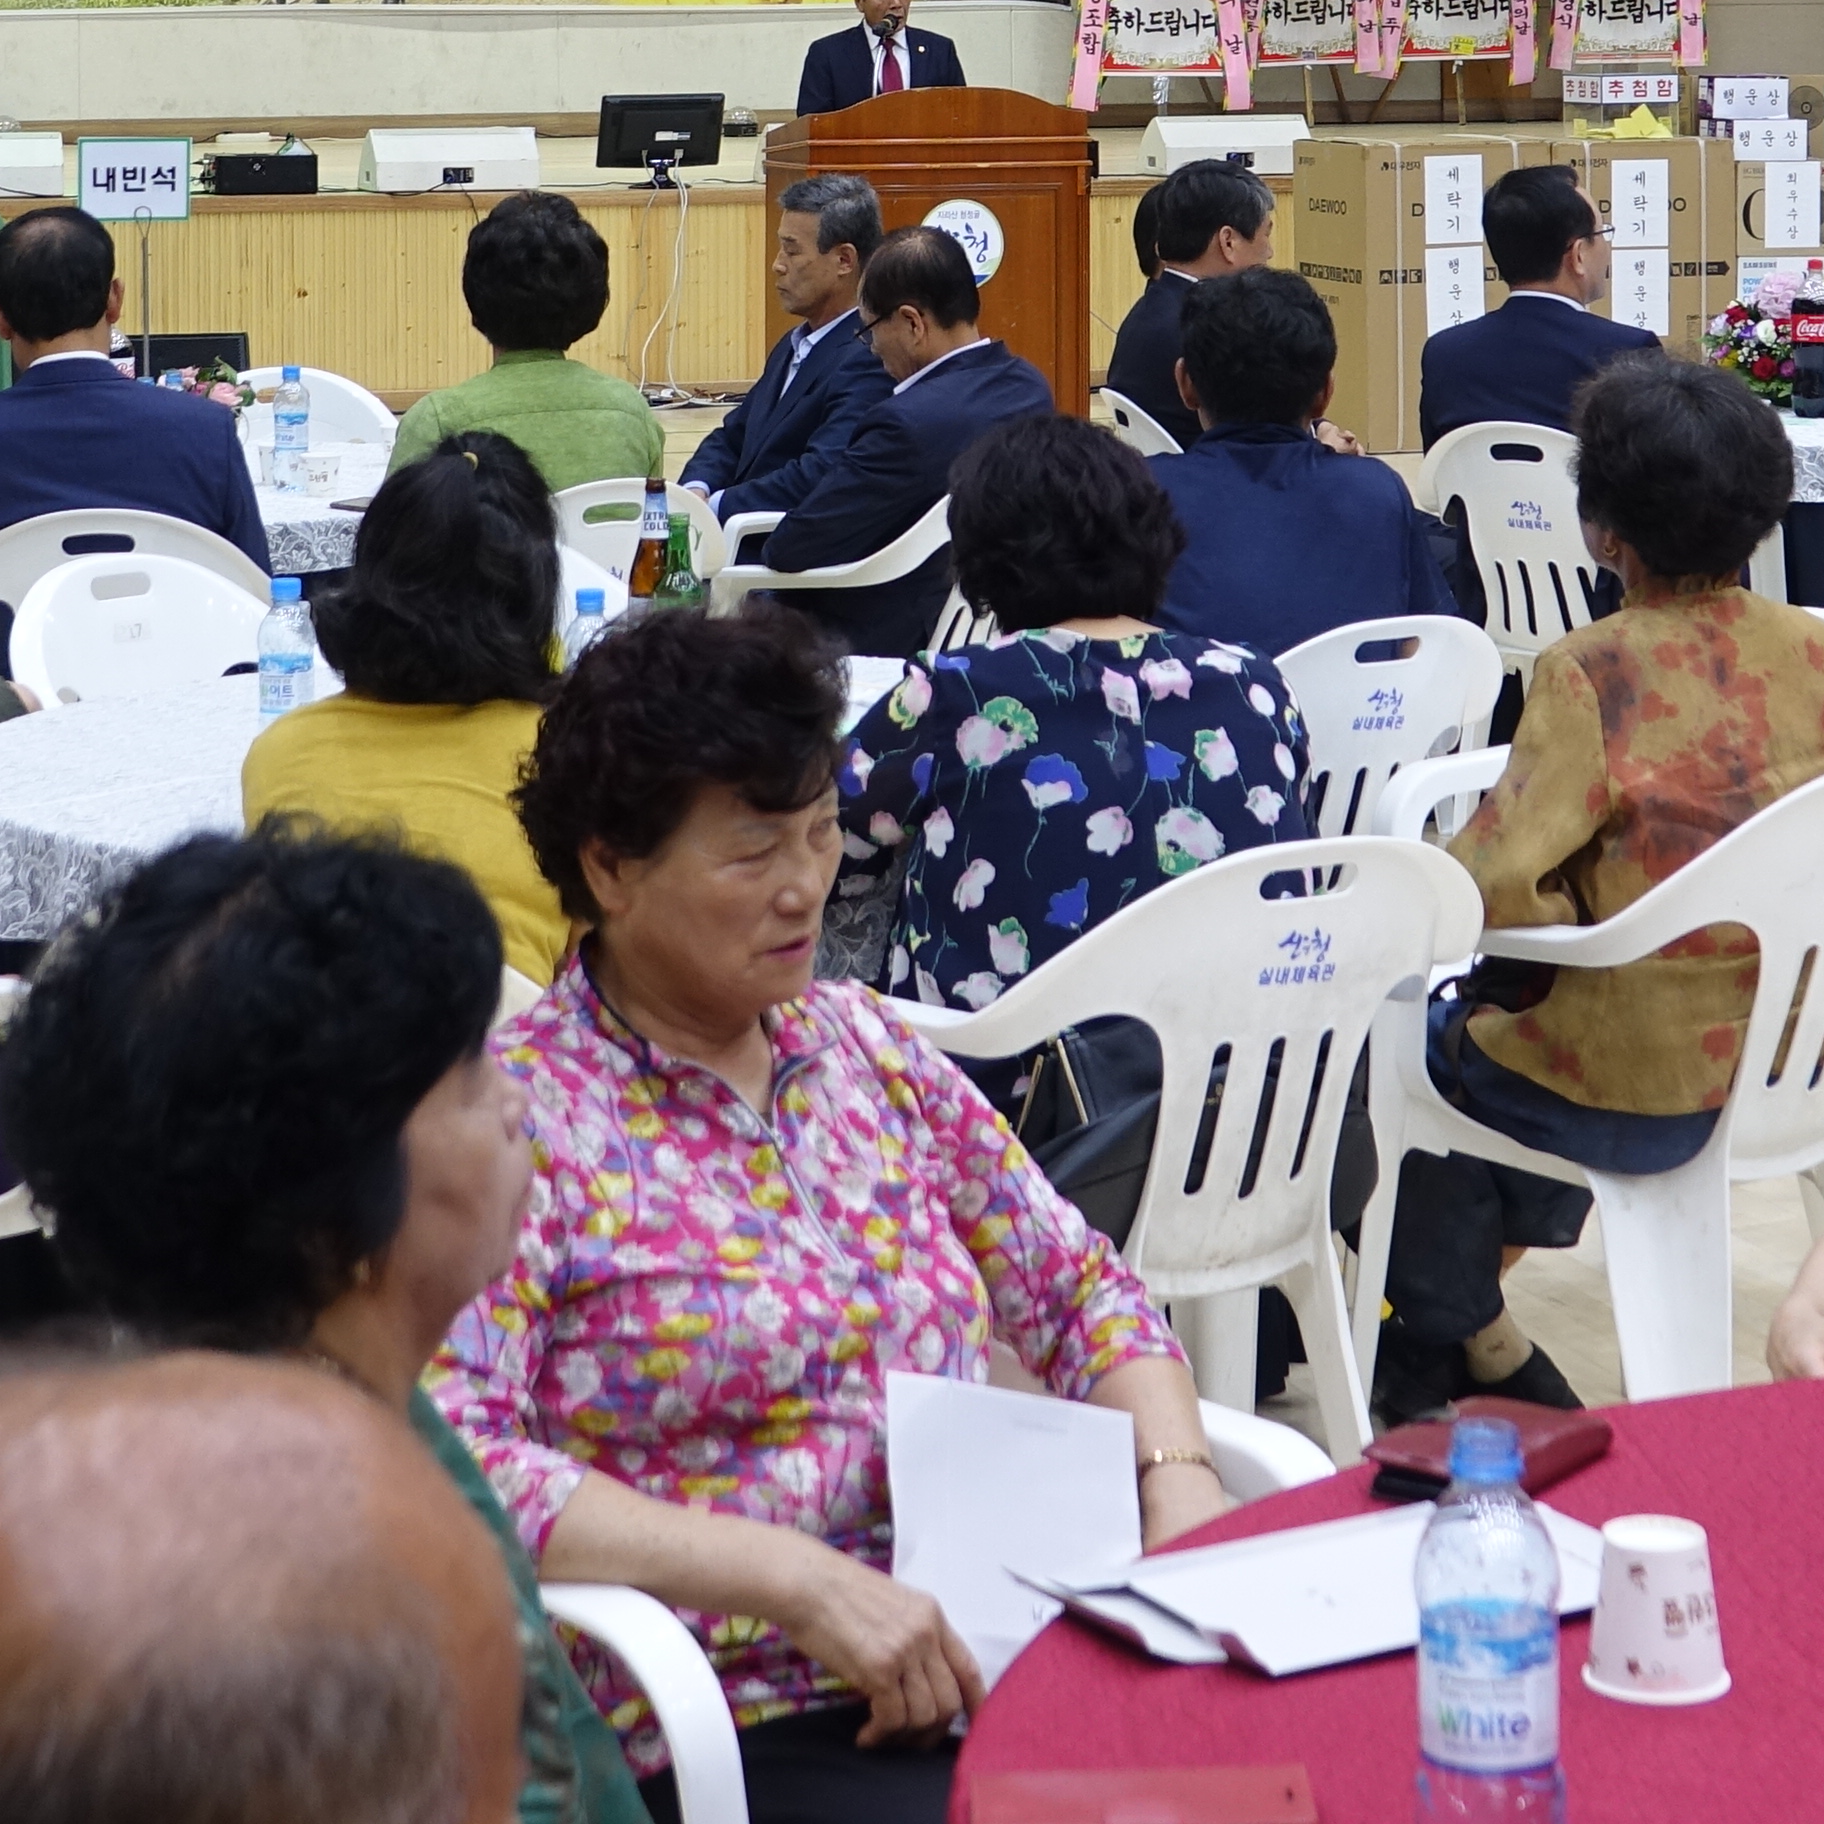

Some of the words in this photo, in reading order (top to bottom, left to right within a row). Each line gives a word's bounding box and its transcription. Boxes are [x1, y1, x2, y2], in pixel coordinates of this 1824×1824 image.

[1357, 19, 1376, 35] 날
[1682, 14, 1700, 27] 날
[1224, 34, 1244, 54] 날
[1566, 80, 1599, 99] 추첨함
[1609, 79, 1673, 98] 추첨함
[92, 163, 176, 194] 내빈석
[1309, 200, 1347, 216] DAEWOO
[1633, 172, 1648, 236] 세탁기
[643, 512, 668, 522] EXTR
